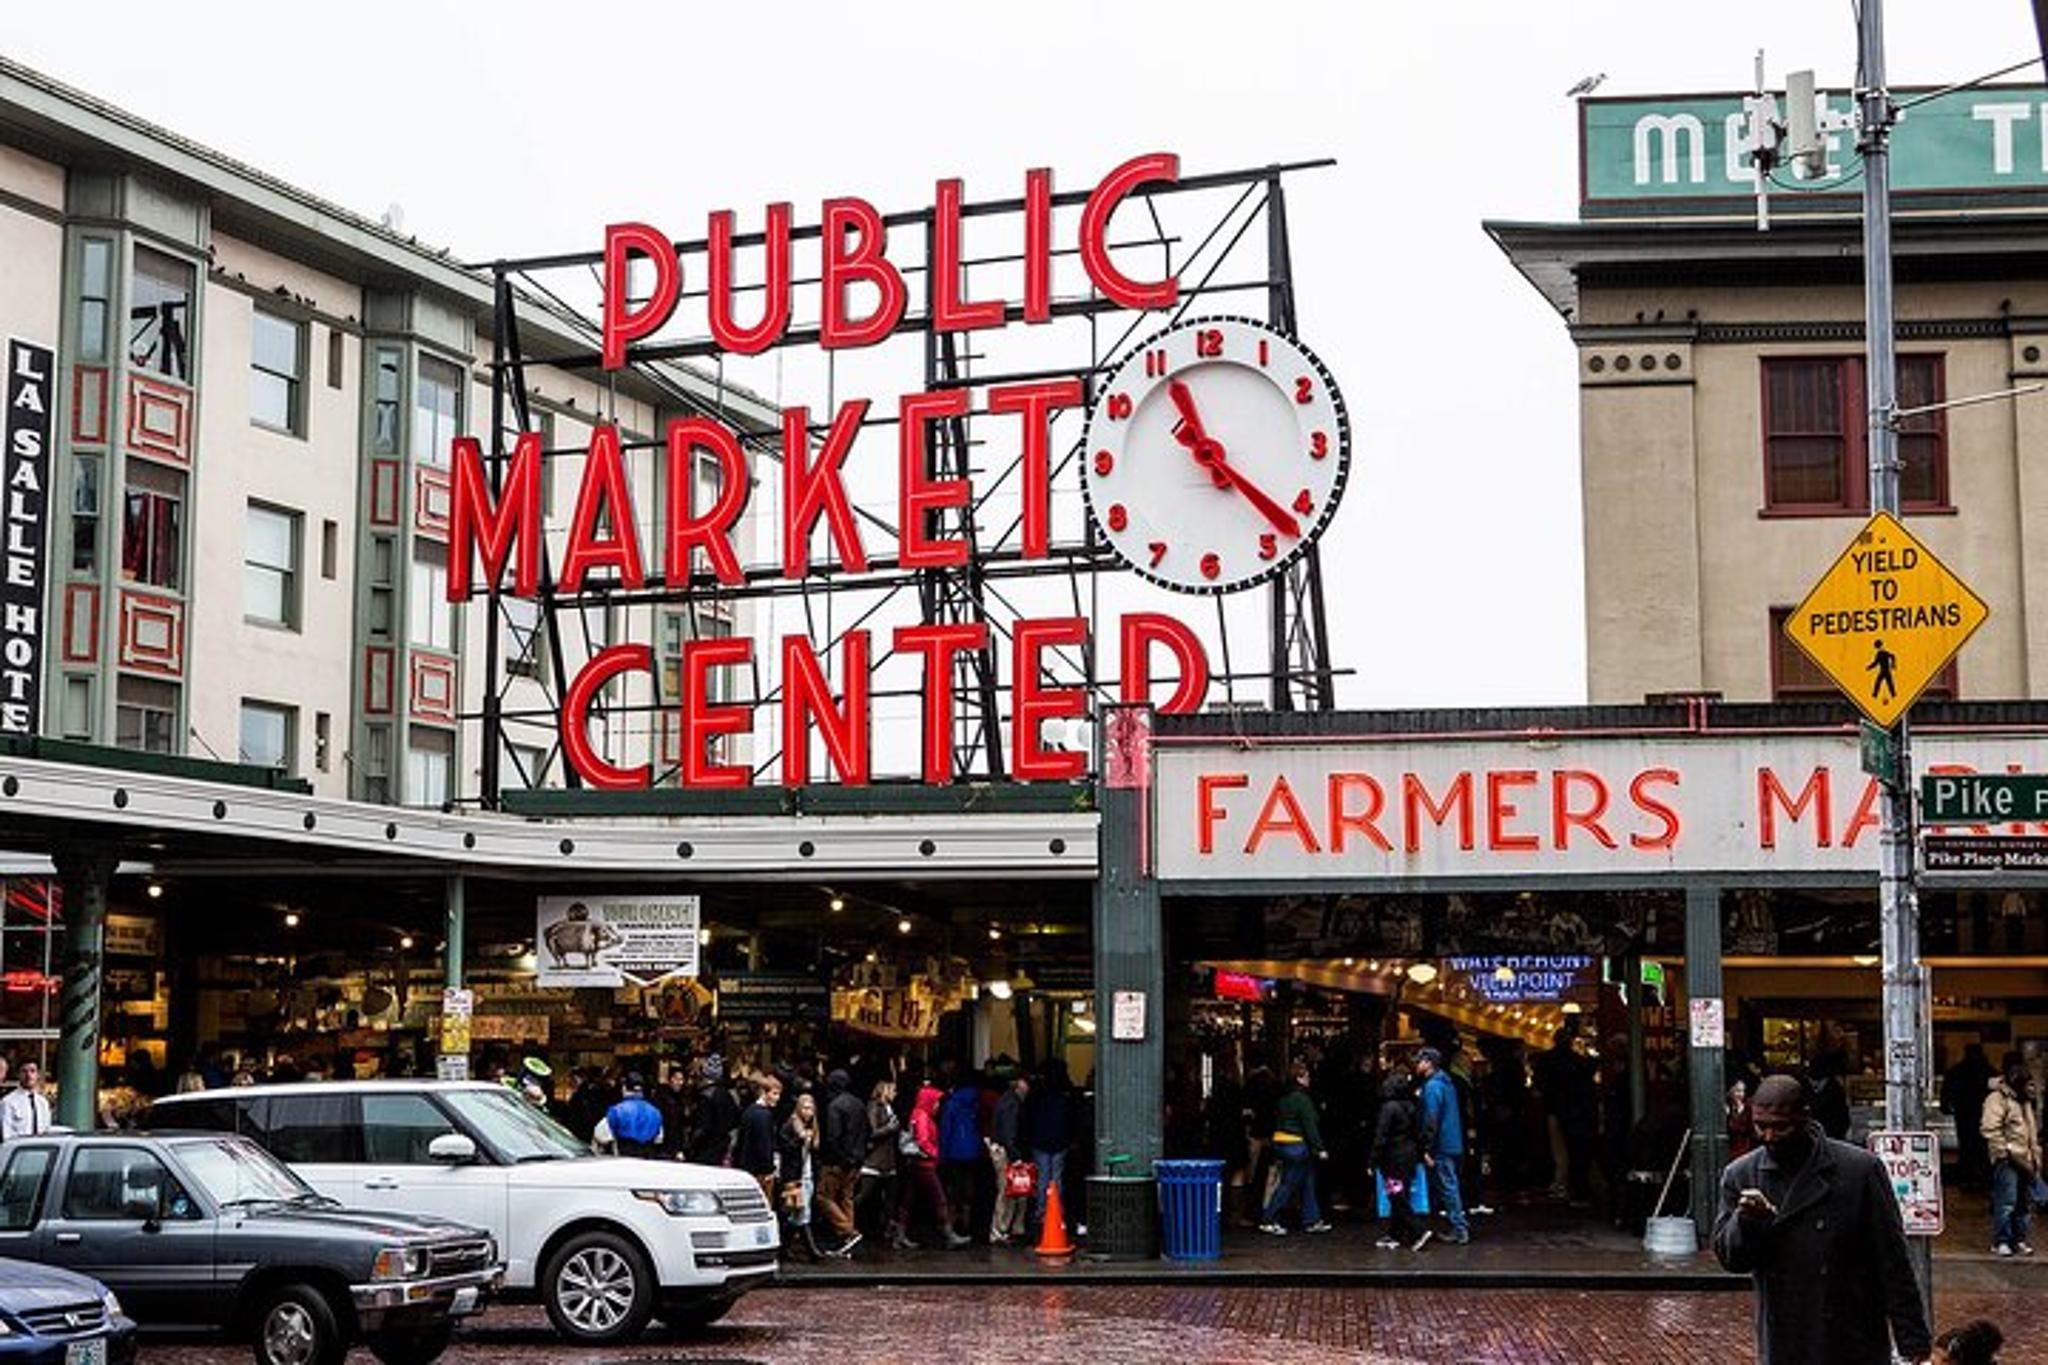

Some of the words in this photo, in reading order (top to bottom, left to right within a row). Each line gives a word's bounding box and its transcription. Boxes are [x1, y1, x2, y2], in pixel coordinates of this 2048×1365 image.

[603, 152, 1180, 370] PUBLIC
[1197, 329, 1223, 358] 12
[1259, 340, 1268, 367] 1
[1146, 349, 1166, 378] 11
[13, 347, 44, 414] LA
[1294, 376, 1313, 404] 2
[1108, 393, 1132, 421] 10
[1309, 431, 1326, 460] 3
[1094, 450, 1113, 477] 9
[447, 379, 1084, 603] MARKET
[1292, 489, 1314, 516] 4
[7, 430, 42, 588] SALLE
[1108, 504, 1127, 532] 8
[1148, 542, 1167, 569] 7
[1259, 534, 1277, 560] 5
[1851, 548, 1917, 574] YIELD
[1200, 553, 1220, 580] 6
[1870, 579, 1898, 602] TO
[1810, 603, 1961, 635] PEDESTRIANS
[1, 603, 36, 734] HOTE
[1936, 778, 2013, 815] Pike
[1198, 769, 1681, 854] FARMERS
[1928, 852, 1961, 866] Pike
[1962, 852, 2003, 866] Place
